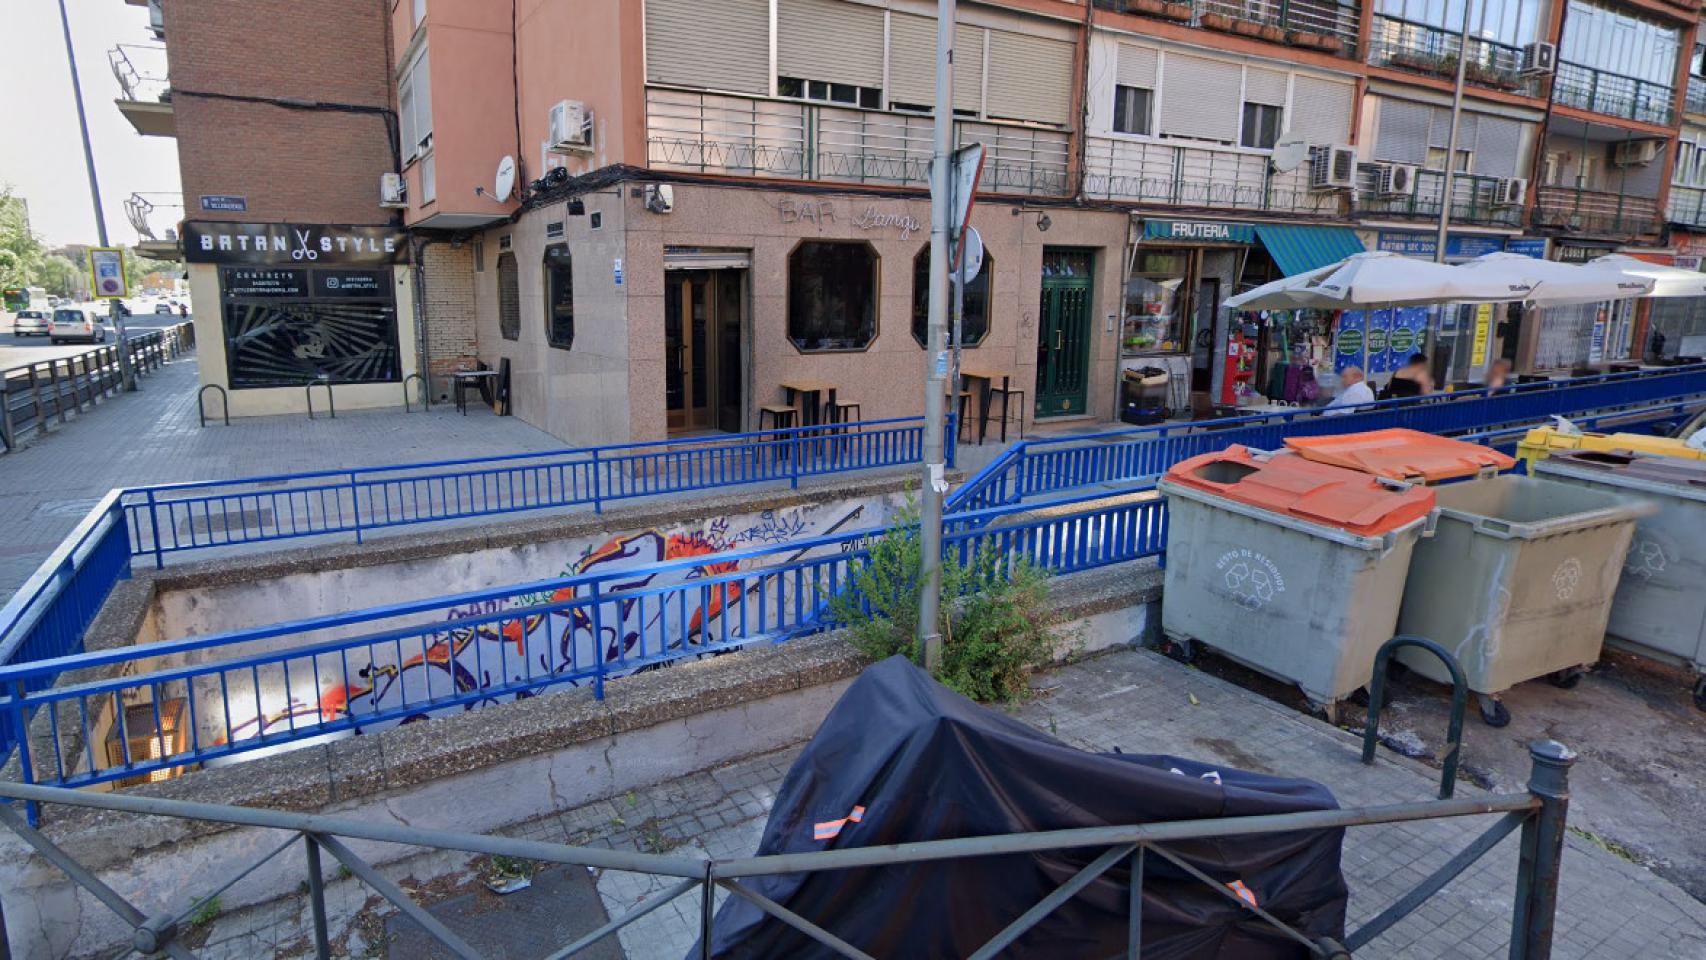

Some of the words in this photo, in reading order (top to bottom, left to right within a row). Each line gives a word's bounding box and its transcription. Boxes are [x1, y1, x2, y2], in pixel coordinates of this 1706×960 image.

[780, 199, 836, 224] BAR
[1171, 223, 1230, 238] FRUTERIA
[200, 234, 286, 251] BATAN
[320, 236, 394, 252] STYLE
[1240, 548, 1253, 558] DE
